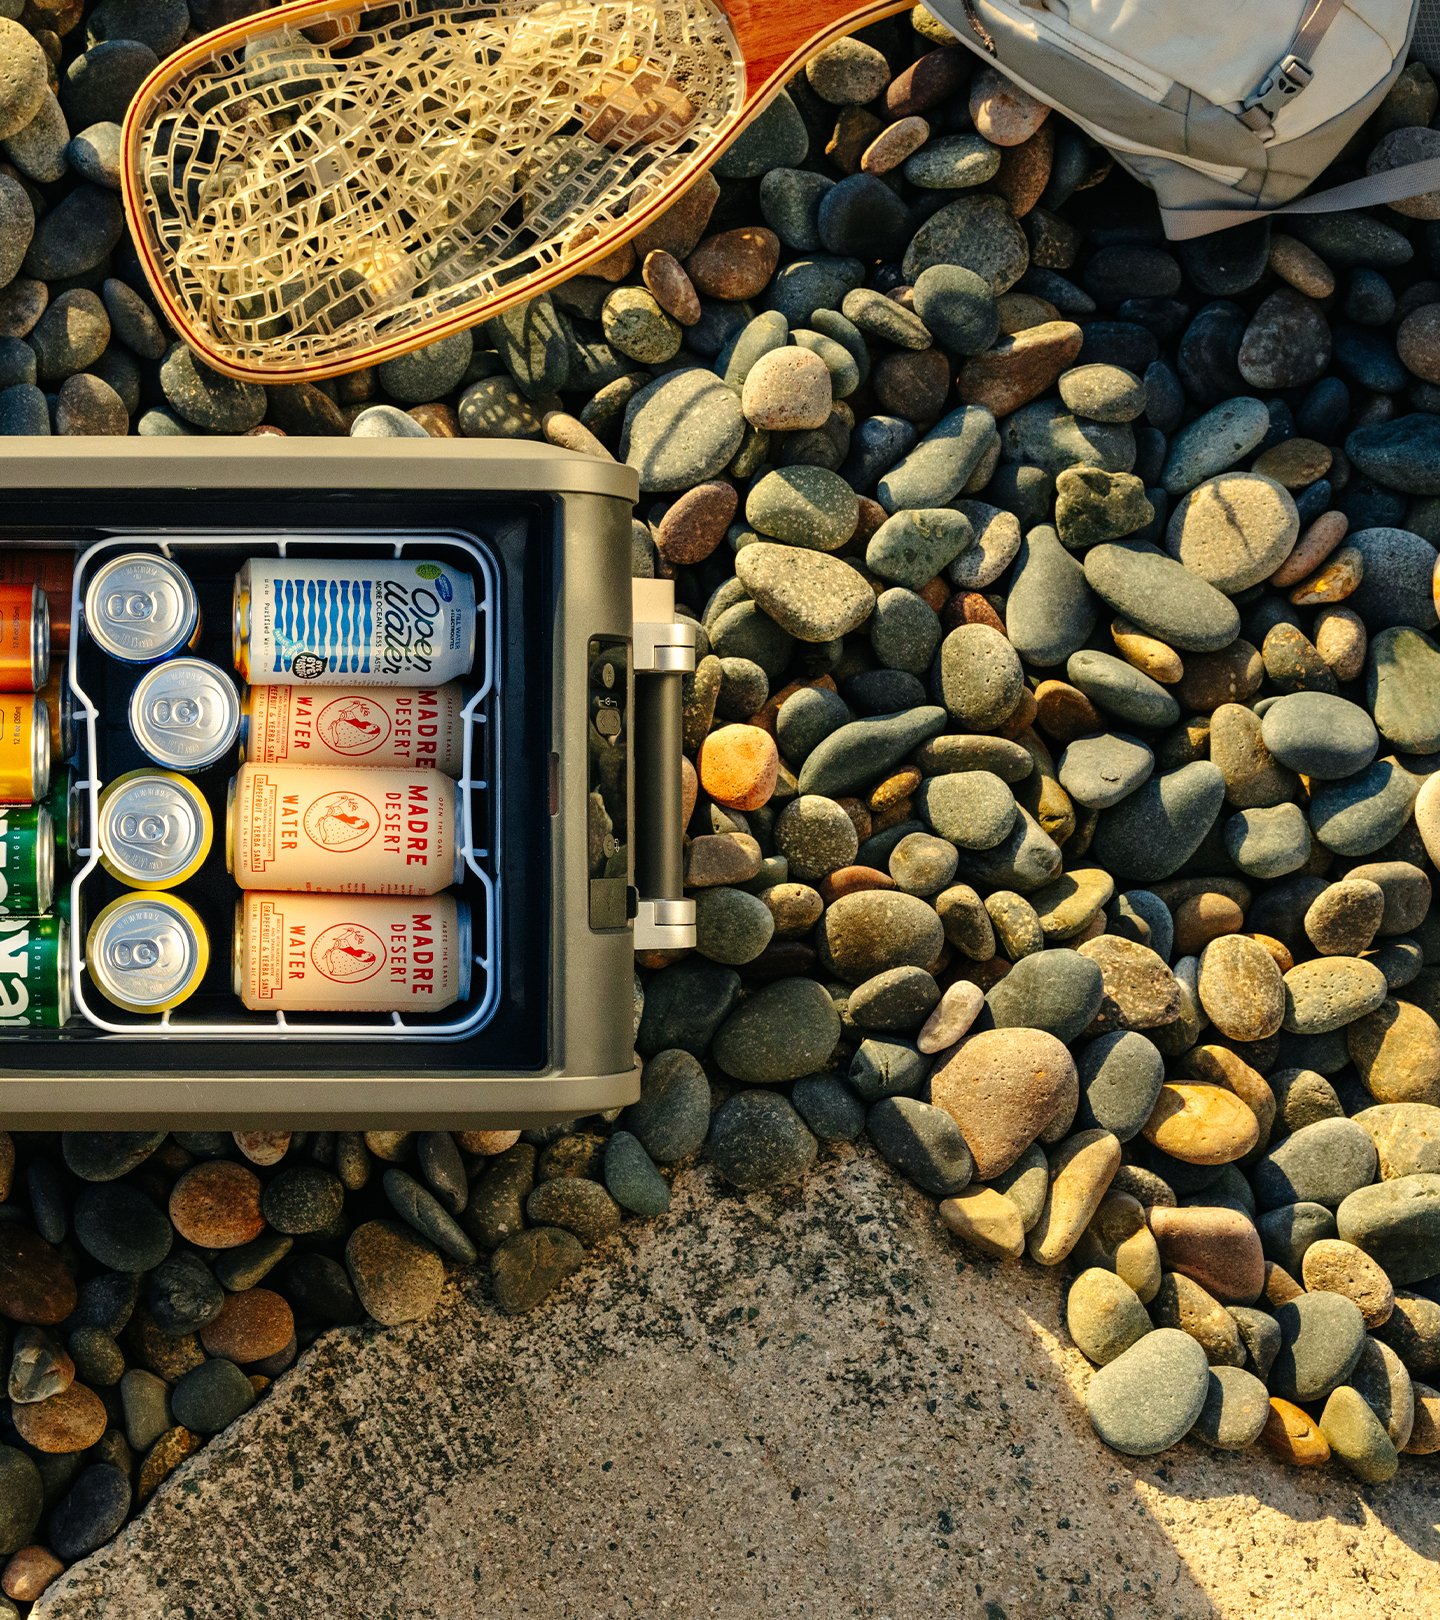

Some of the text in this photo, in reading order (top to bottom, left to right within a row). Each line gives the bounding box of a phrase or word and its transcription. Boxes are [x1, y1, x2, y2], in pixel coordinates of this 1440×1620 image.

[382, 580, 412, 674] Water
[409, 588, 440, 673] Open
[294, 697, 312, 749] WATER
[394, 698, 412, 758] DESERT
[416, 690, 438, 769] MADRE
[255, 777, 264, 813] GRAPEFRUIT
[281, 795, 299, 849] WATER
[384, 792, 401, 854] DESERT
[254, 825, 262, 847] YERBA
[406, 785, 428, 866] MADRE
[262, 905, 270, 943] GRAPEFRUIT
[289, 926, 306, 979] WATER
[390, 924, 406, 984] DESERT
[412, 914, 434, 994] MADRE
[261, 979, 269, 996] SANTA
